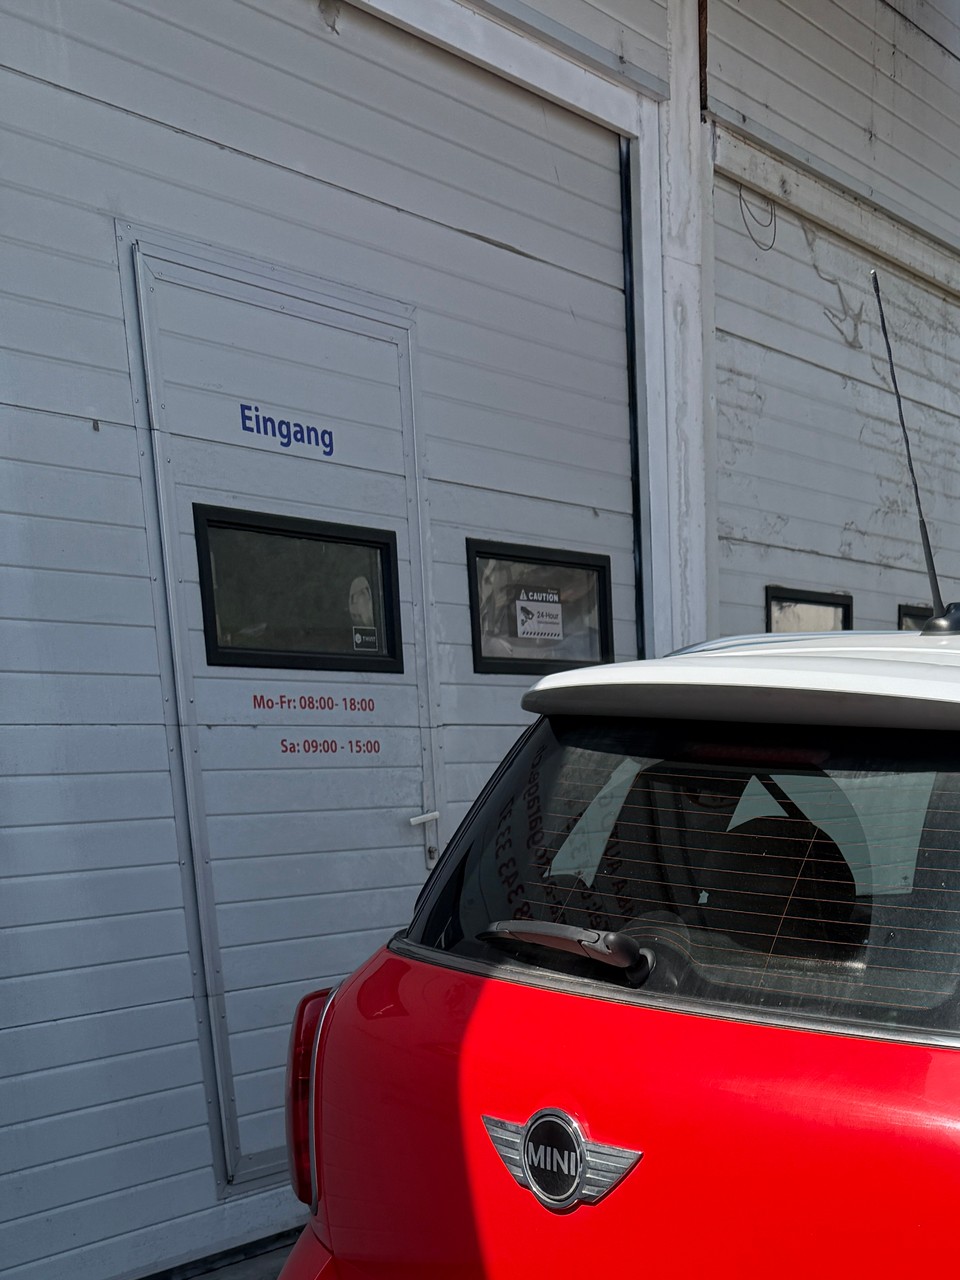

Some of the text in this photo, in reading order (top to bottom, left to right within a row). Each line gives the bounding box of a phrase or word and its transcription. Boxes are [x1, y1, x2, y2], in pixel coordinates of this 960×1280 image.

[240, 403, 334, 456] Eingang
[528, 592, 559, 602] CAUTION
[253, 695, 296, 709] Mo-Fr:
[342, 697, 375, 712] 18:00
[280, 739, 300, 753] Sa:
[303, 740, 337, 753] 09:00
[348, 740, 381, 753] 15:00
[528, 1141, 577, 1176] MINI
